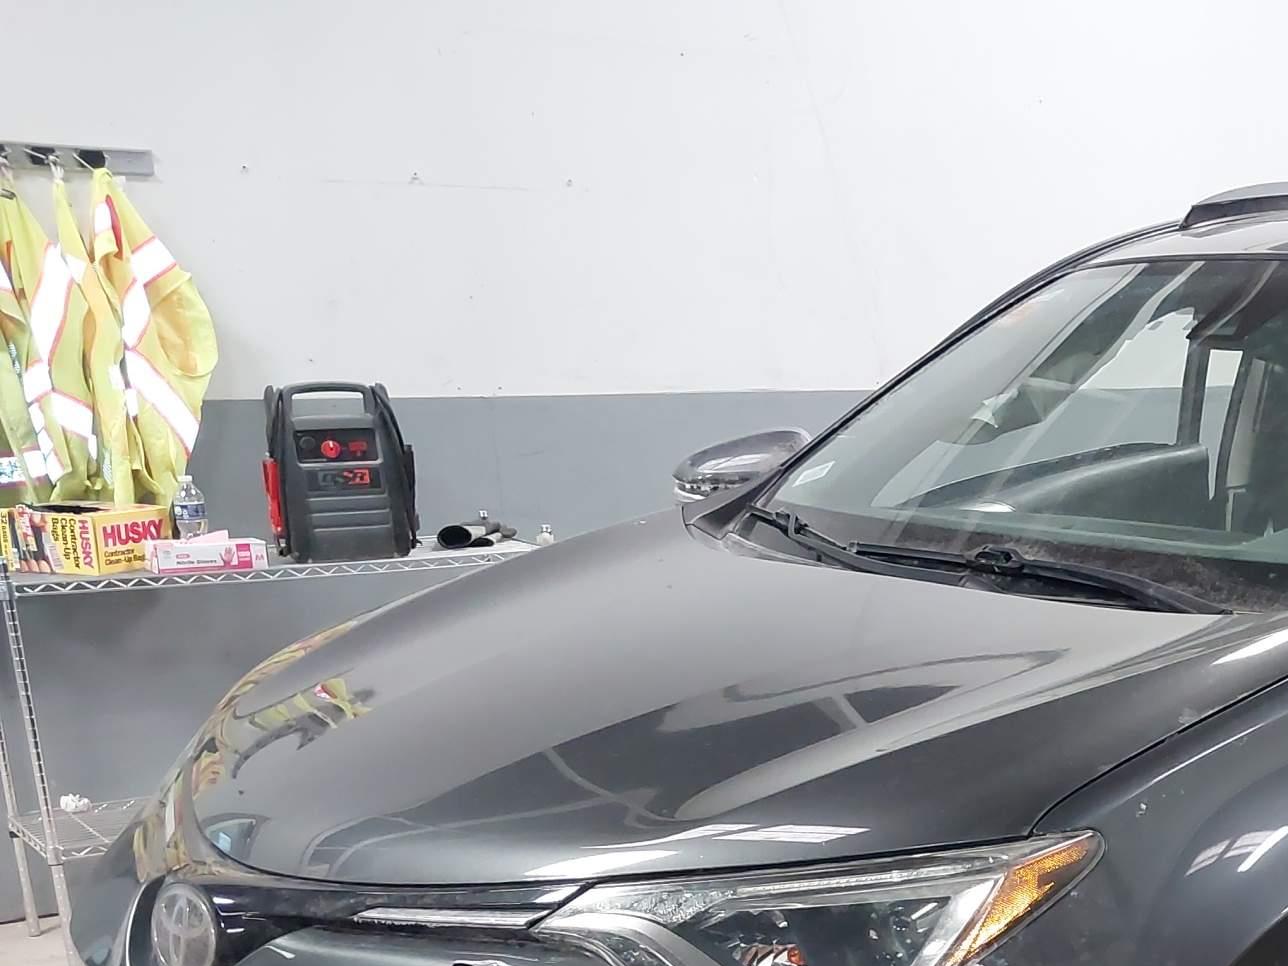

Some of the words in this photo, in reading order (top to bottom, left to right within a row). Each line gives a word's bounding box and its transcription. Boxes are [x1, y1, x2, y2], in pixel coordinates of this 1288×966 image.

[51, 517, 60, 541] Bags
[68, 518, 80, 569] Contractor
[78, 519, 94, 569] HUSKY
[102, 518, 164, 548] HUSKY
[104, 549, 135, 558] Contractor
